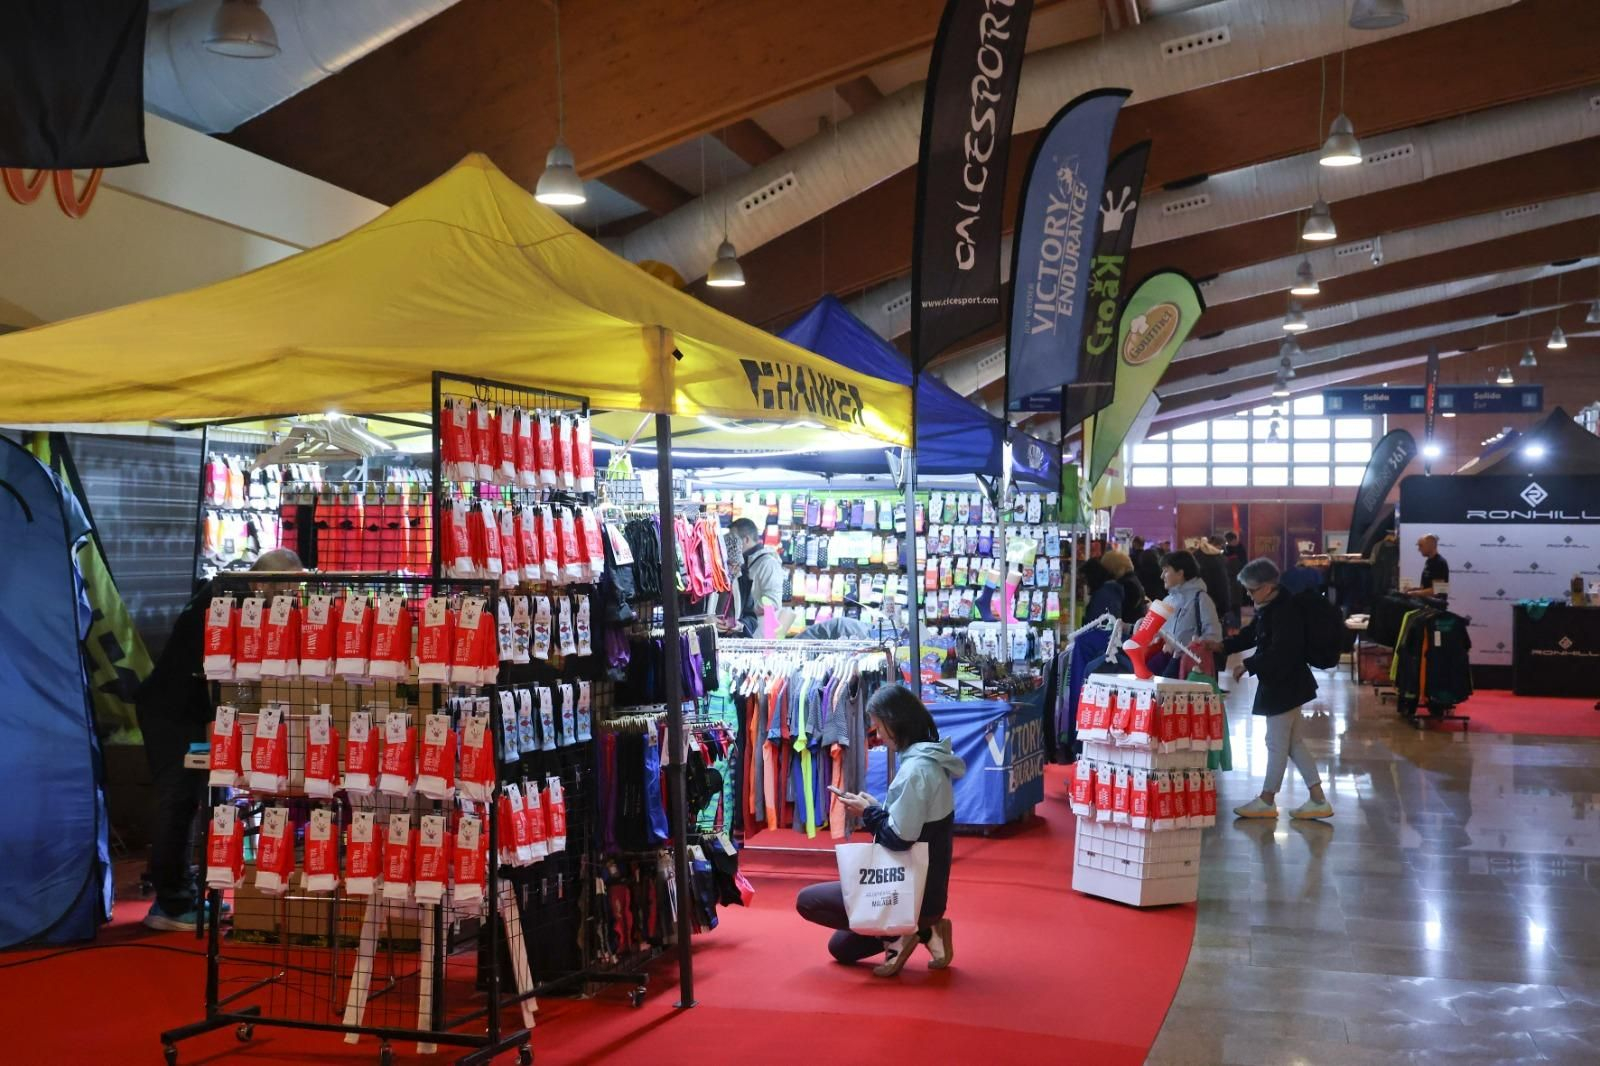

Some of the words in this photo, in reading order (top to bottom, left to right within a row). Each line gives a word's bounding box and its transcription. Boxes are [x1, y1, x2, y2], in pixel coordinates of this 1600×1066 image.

[1058, 185, 1089, 317] ENDURANCE
[1031, 193, 1070, 335] VICTORY
[1466, 510, 1600, 520] RONHILL
[1531, 649, 1600, 657] RONHILL
[859, 866, 905, 885] 226ERS
